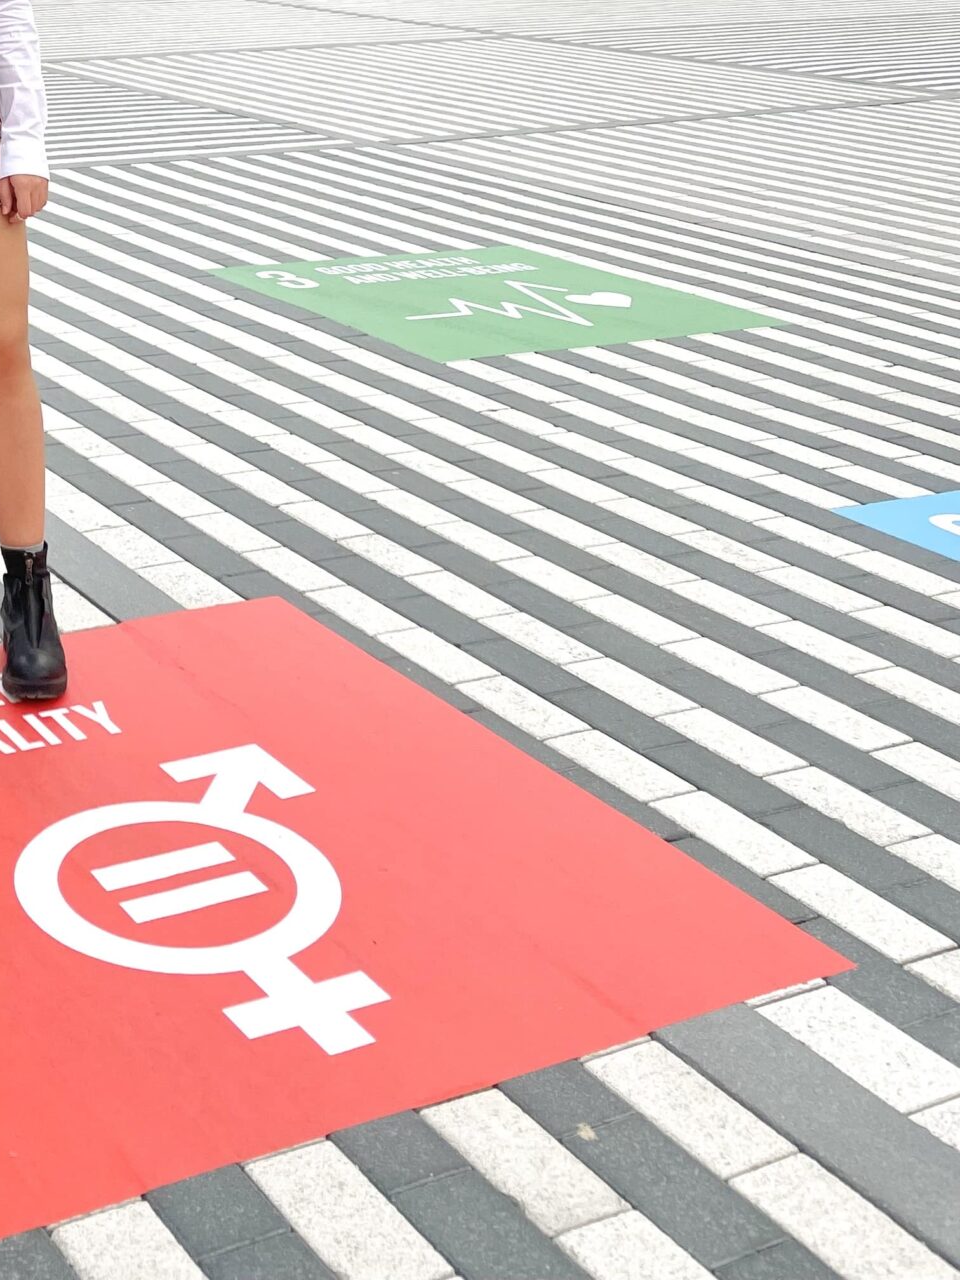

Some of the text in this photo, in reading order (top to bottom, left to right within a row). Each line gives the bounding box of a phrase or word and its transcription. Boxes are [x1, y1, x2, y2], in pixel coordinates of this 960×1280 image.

[314, 256, 482, 276] GOOD HEALTH
[255, 270, 320, 289] 3
[342, 272, 402, 285] AND
